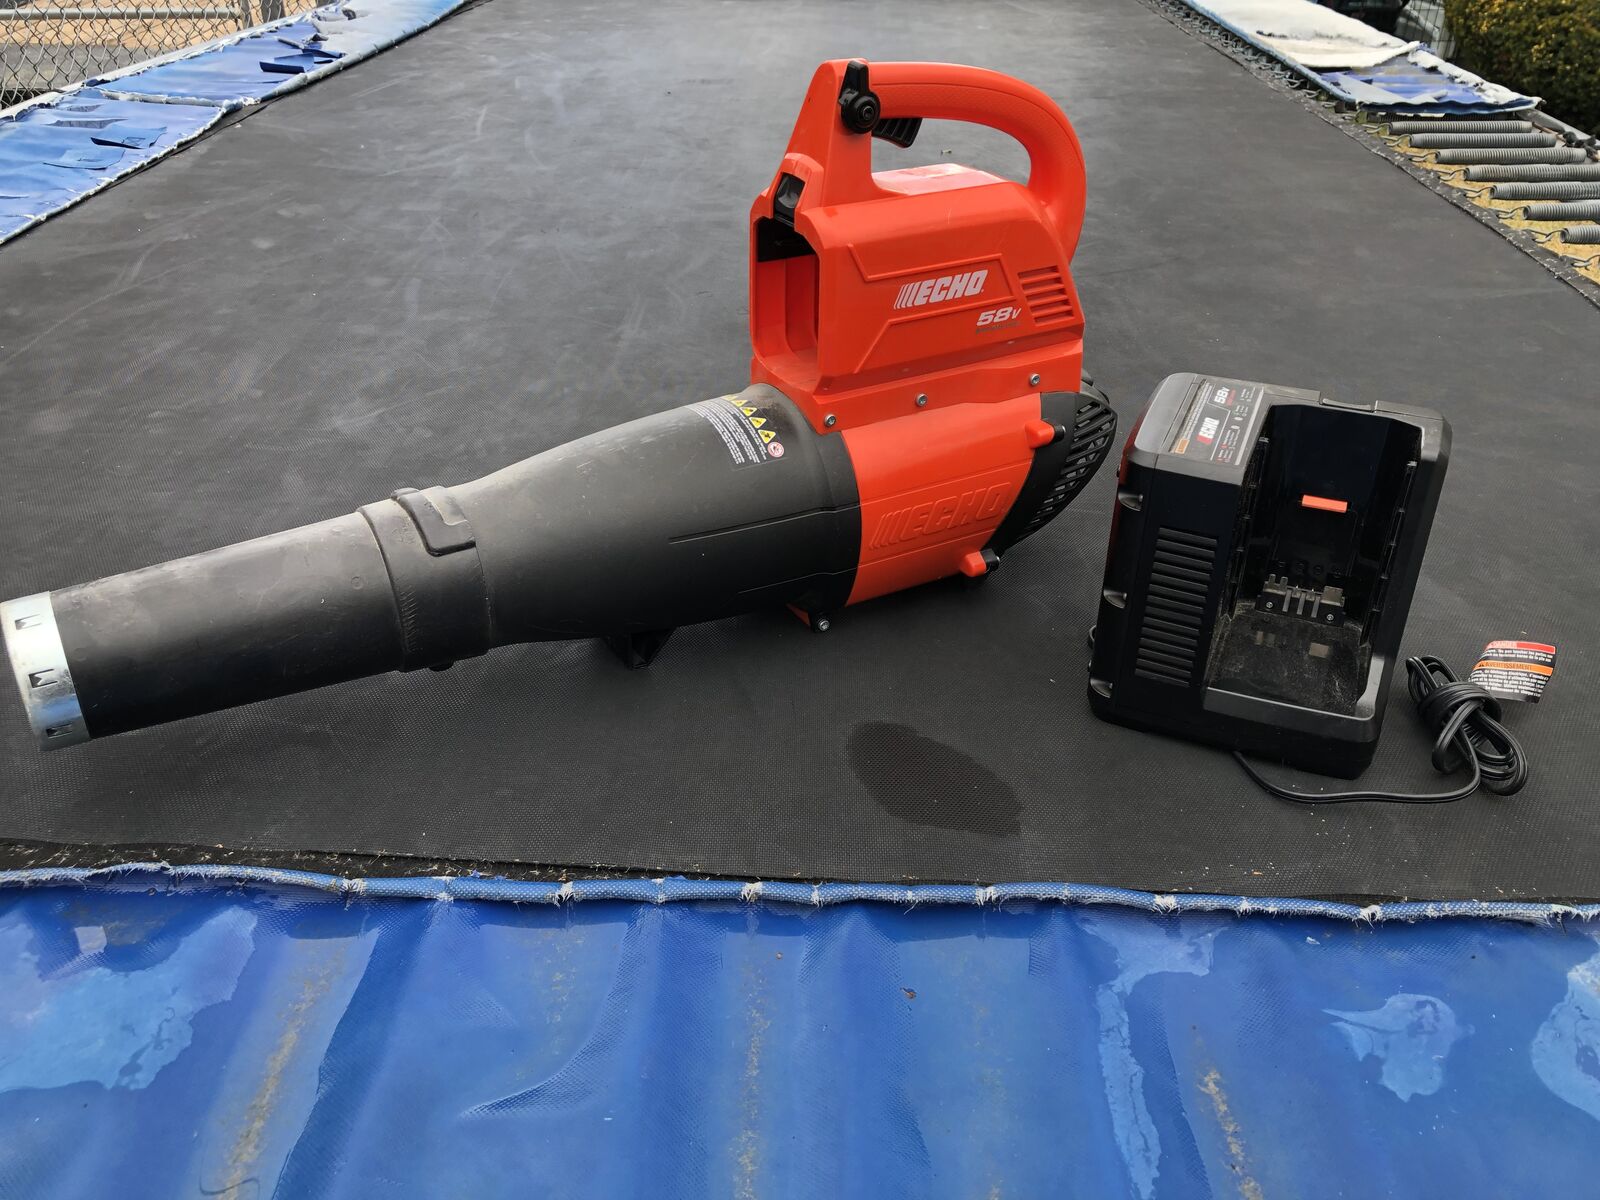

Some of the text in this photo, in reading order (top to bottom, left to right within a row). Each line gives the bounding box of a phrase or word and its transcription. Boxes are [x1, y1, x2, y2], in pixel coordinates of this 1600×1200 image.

[913, 269, 988, 306] ECHO
[1198, 417, 1220, 439] ECHO
[899, 482, 1013, 542] ECHO
